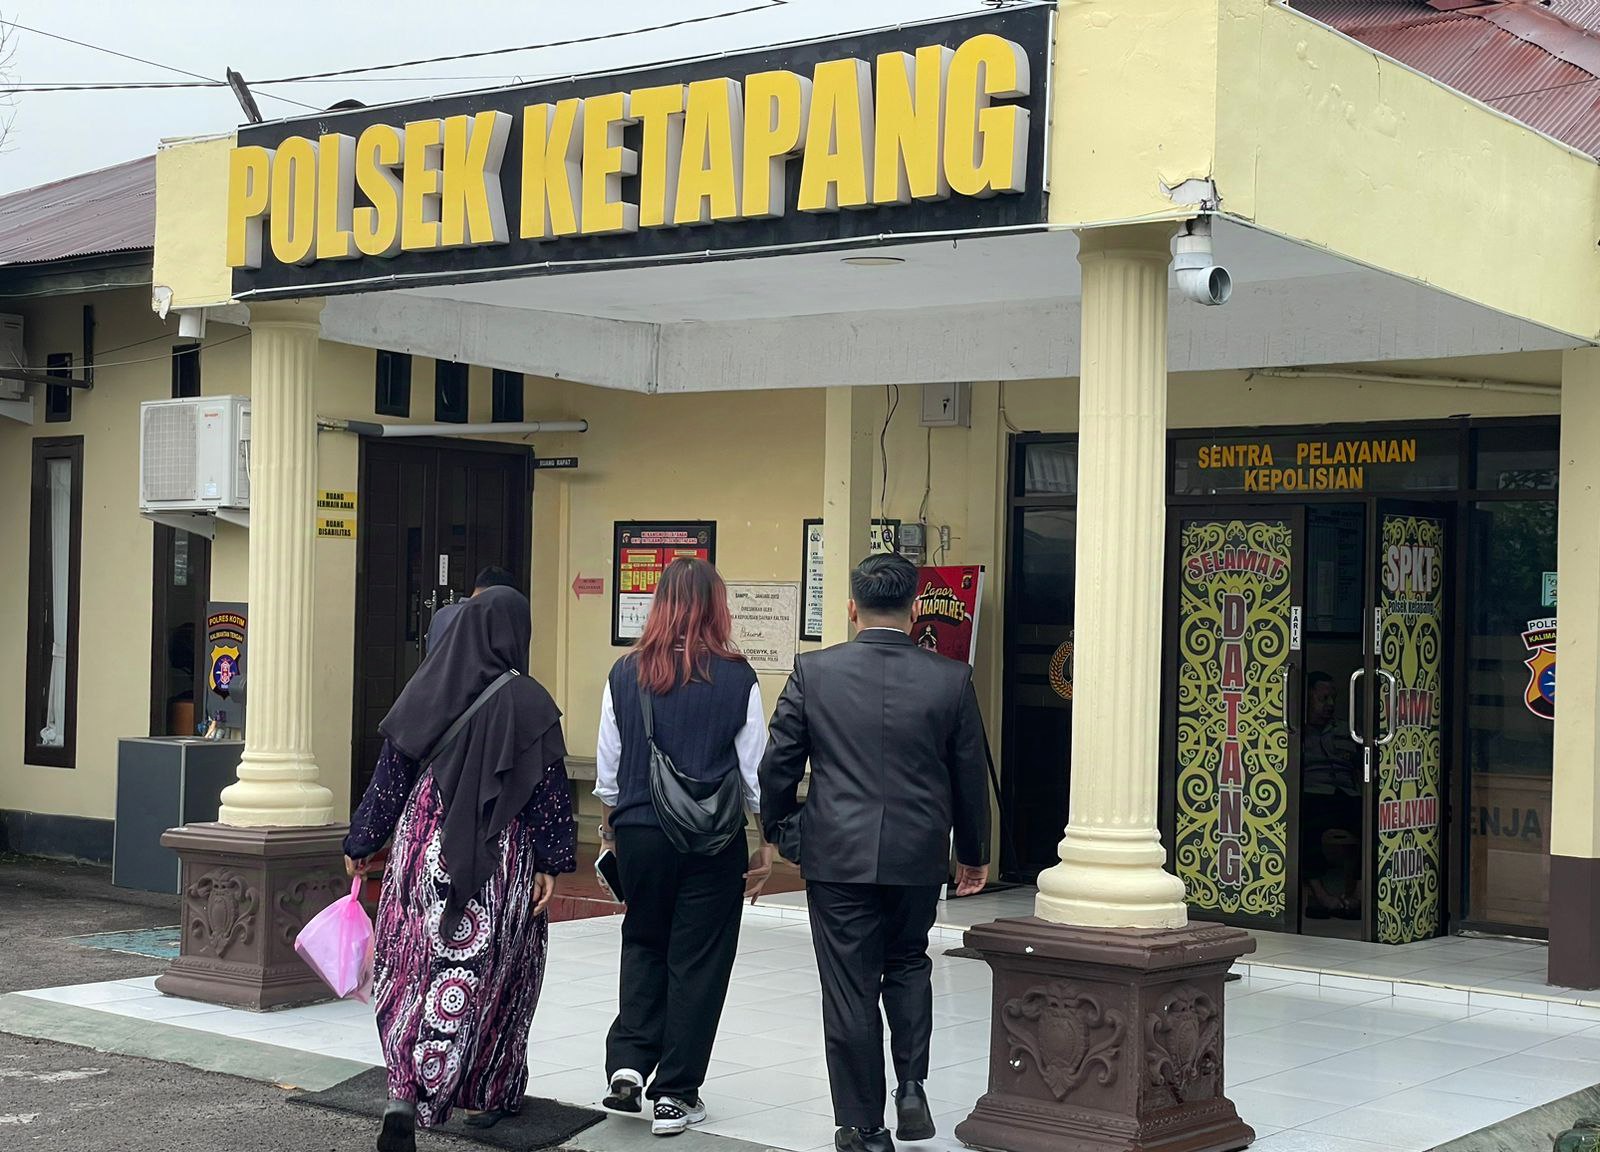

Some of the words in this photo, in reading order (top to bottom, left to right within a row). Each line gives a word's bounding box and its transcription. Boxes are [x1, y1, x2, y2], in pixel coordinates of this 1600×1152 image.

[226, 111, 511, 269] POLSEK
[520, 34, 1030, 240] KETAPANG
[1198, 444, 1274, 469] SENTRA
[1297, 439, 1416, 465] PELAYANAN
[1244, 467, 1364, 491] KEPOLISIAN
[326, 492, 344, 500] RUANG
[318, 528, 351, 537] DISABILITAS
[326, 520, 344, 528] RUANG
[1187, 547, 1285, 580] SELAMAT
[1387, 544, 1435, 592] SPKT
[919, 581, 954, 600] Lapor
[209, 614, 229, 626] POLRES
[229, 615, 245, 627] KOTIM
[1218, 592, 1246, 888] DATANG
[1395, 750, 1422, 781] SIAP
[1379, 798, 1437, 832] MELAYANI
[1392, 847, 1424, 880] ANDA
